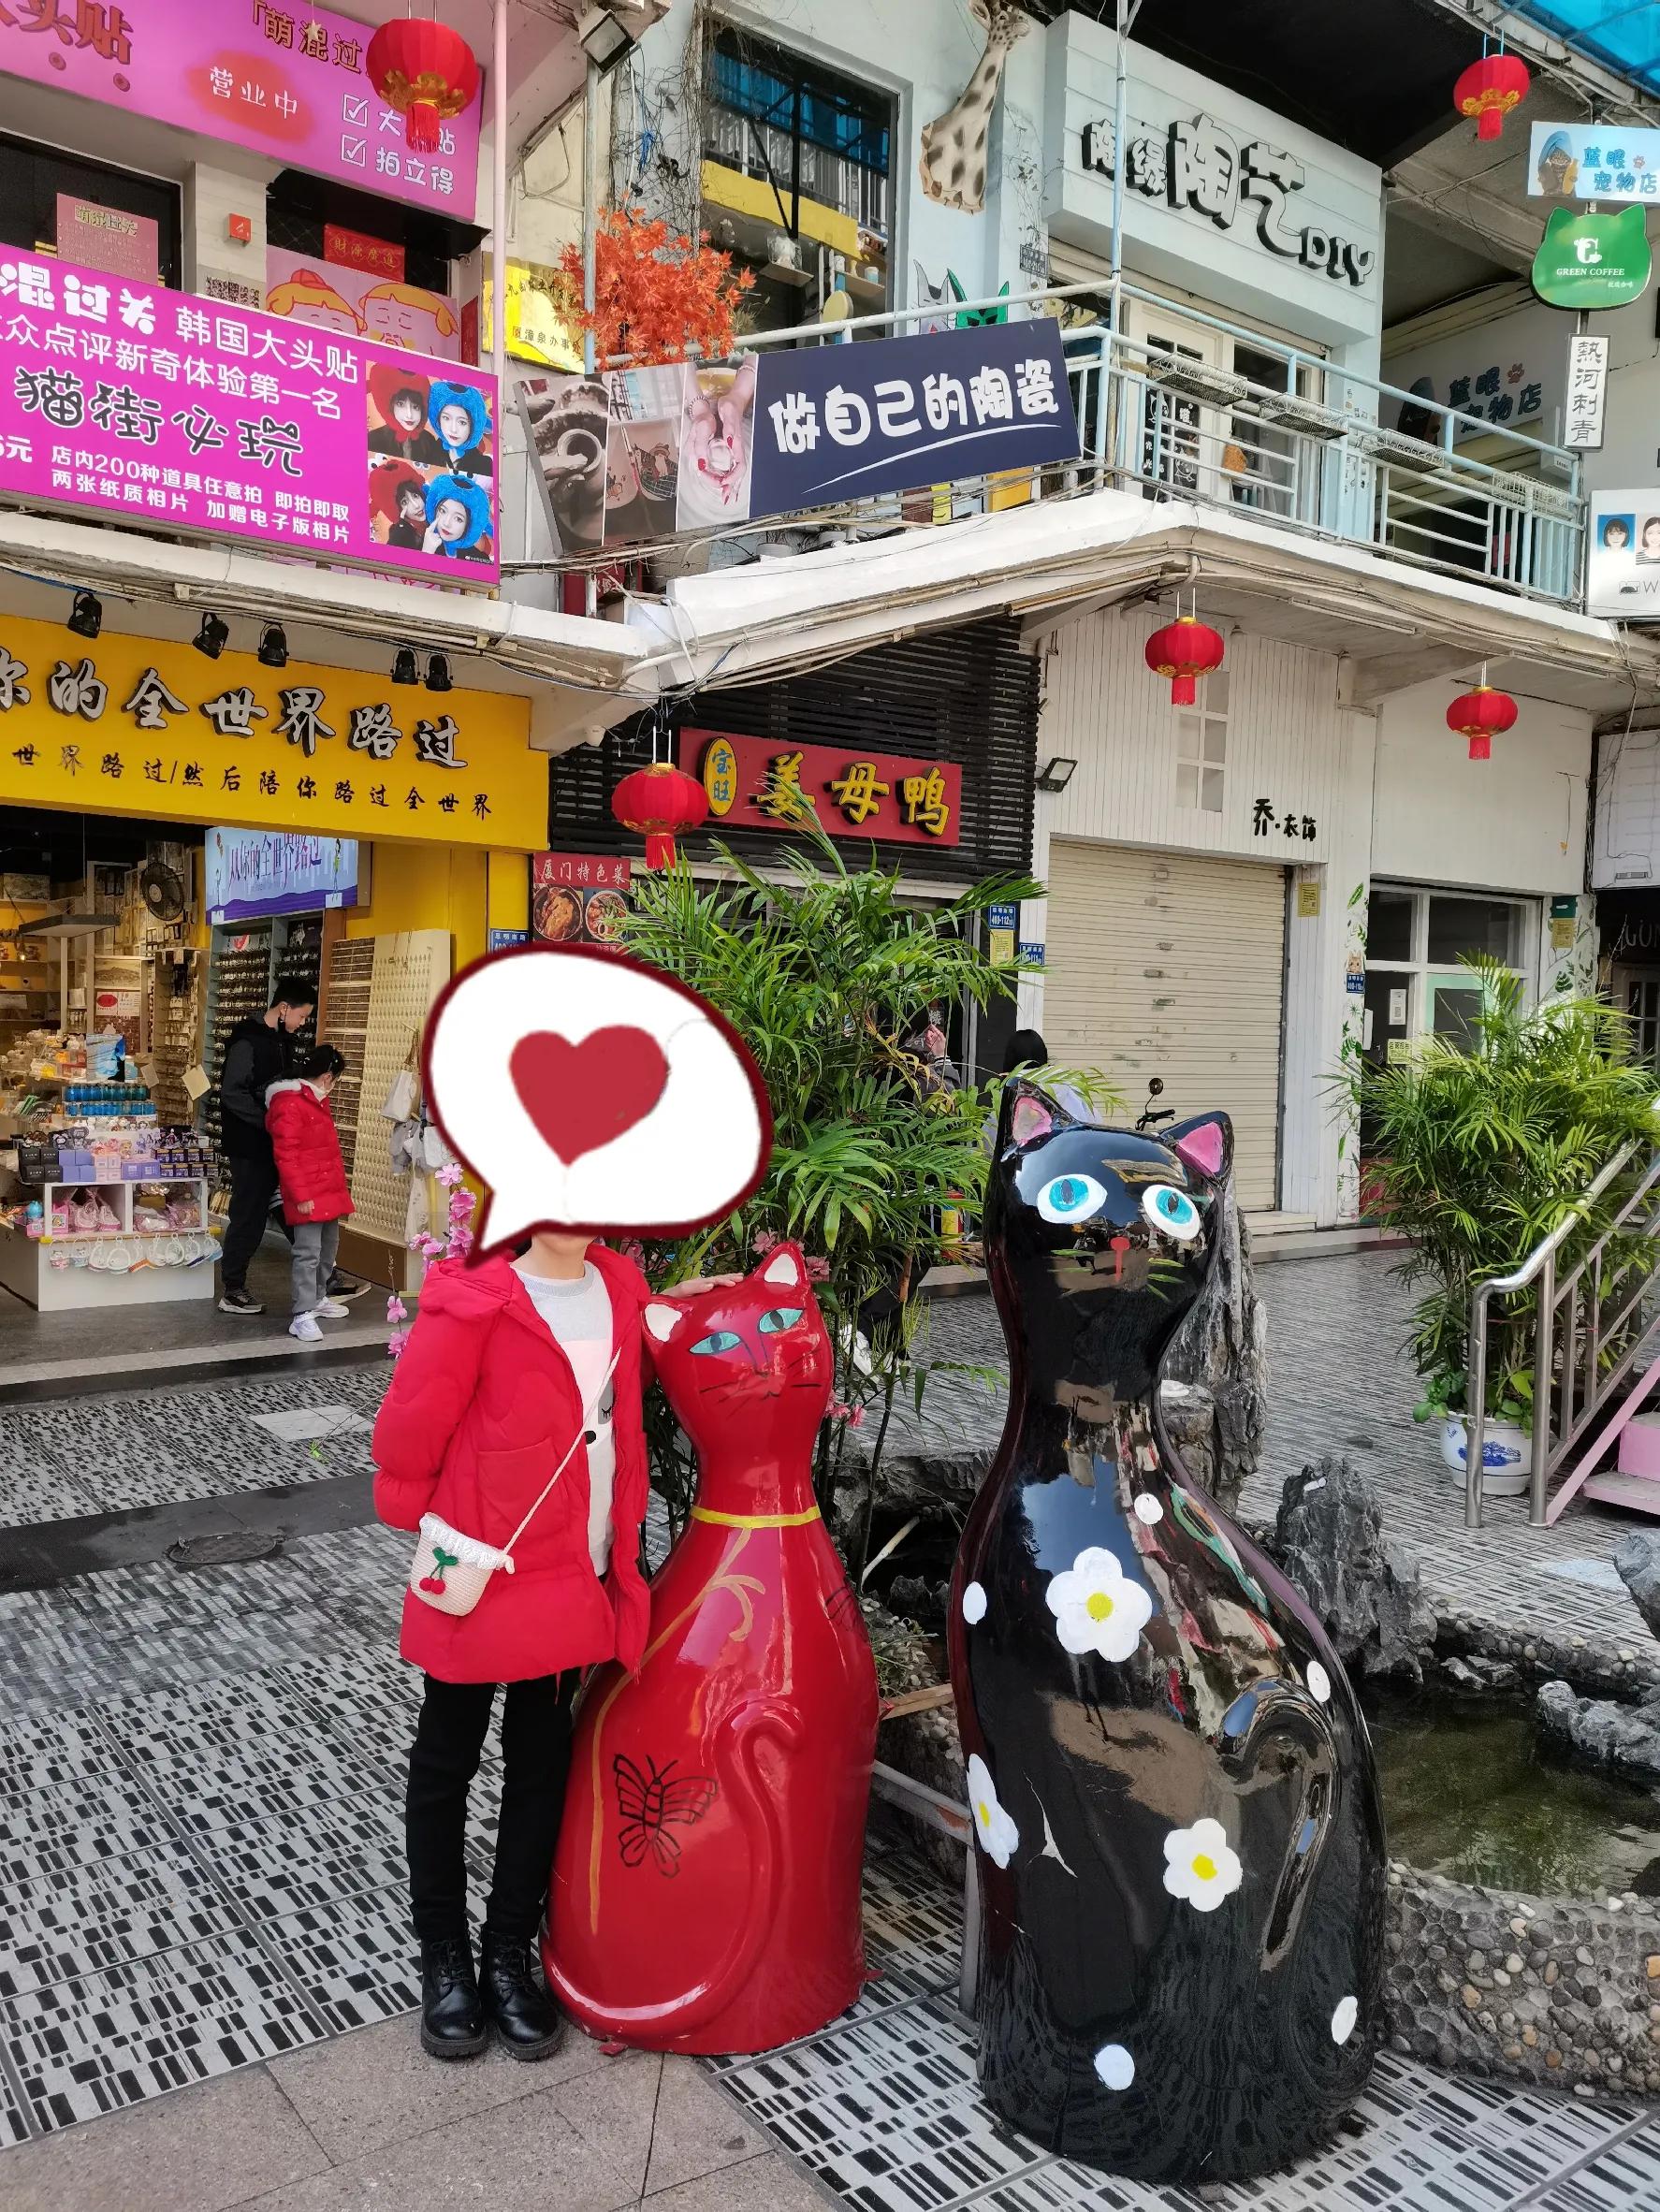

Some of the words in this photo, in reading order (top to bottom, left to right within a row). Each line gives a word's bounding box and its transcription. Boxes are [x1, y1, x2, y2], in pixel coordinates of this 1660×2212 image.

[0, 0, 133, 65] 头贴
[209, 66, 298, 120] 营业中
[378, 109, 456, 155] 大贴
[1582, 146, 1626, 169] 蓝眼
[375, 146, 454, 195] 拍立得
[1594, 170, 1657, 195] 宠物店
[1556, 268, 1588, 276] GREEN
[1589, 268, 1625, 276] COFFEE
[0, 313, 342, 419] 众点评新奇体验第一名
[175, 305, 358, 384] 韩国大头贴
[14, 365, 305, 477] 猫街必玩
[767, 358, 1059, 454] 做自己的陶瓷
[51, 445, 263, 505] 店内200种道具任意拍
[275, 490, 350, 523] 即拍即取
[51, 469, 189, 512] 两张纸质相片
[206, 500, 349, 544] 加赠电子版相片
[711, 748, 734, 803] 宝旺
[757, 750, 951, 837] 姜母鸭
[544, 858, 626, 885] 厦门特色菜
